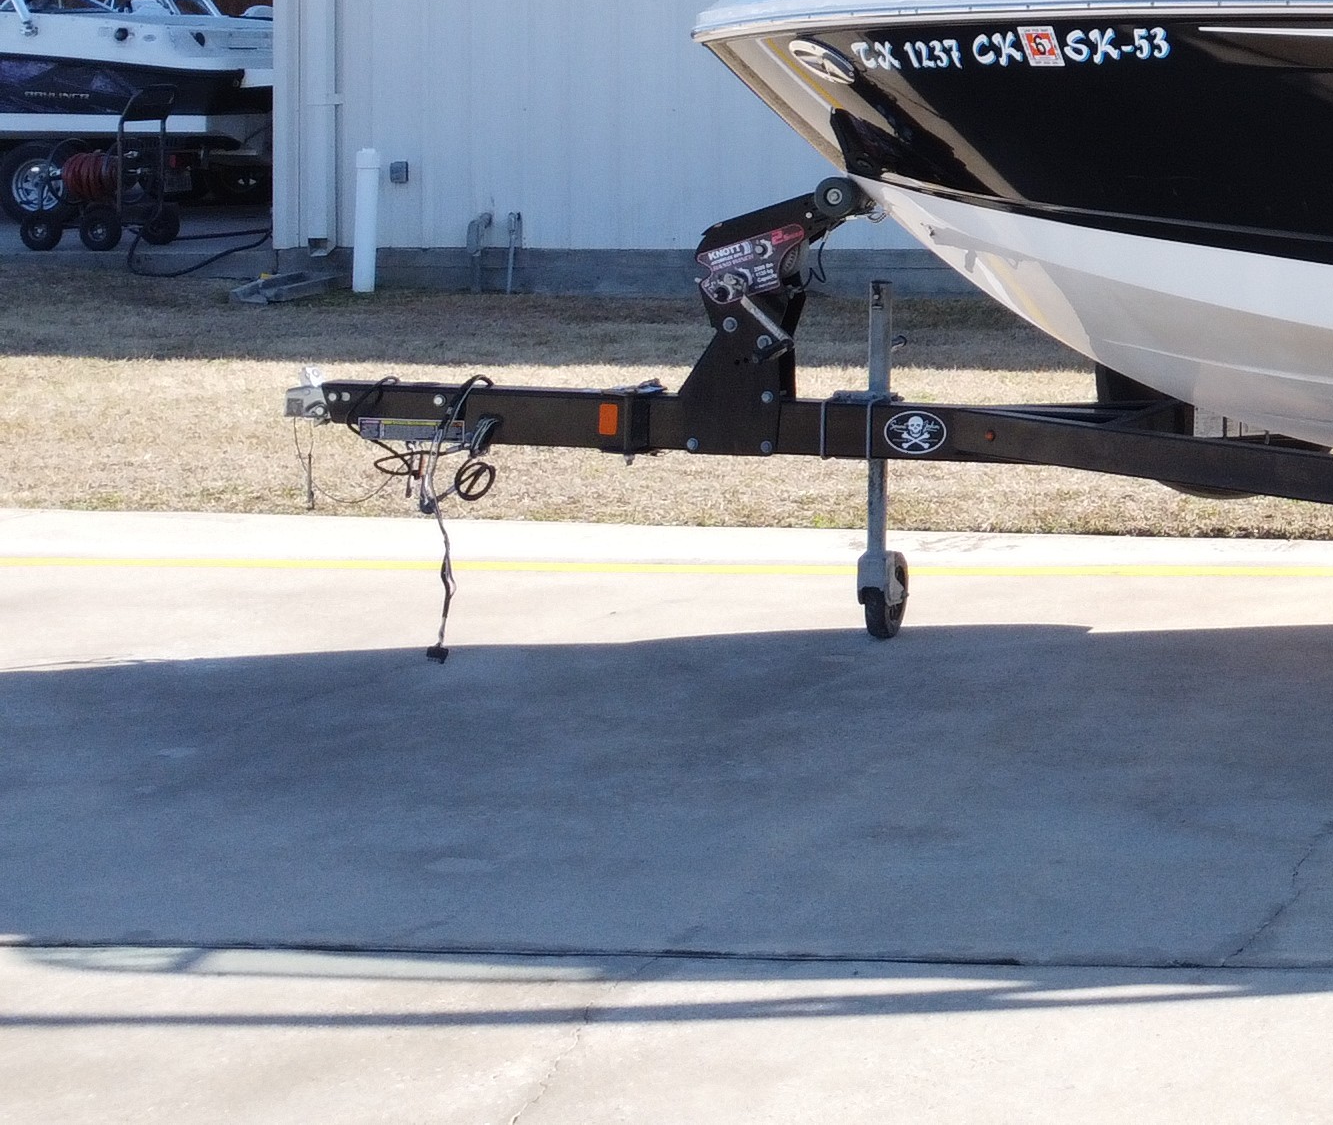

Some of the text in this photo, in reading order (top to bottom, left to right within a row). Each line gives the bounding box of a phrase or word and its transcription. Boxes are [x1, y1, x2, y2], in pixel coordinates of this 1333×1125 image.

[851, 40, 901, 70] TX
[904, 38, 963, 70] 1237
[707, 243, 740, 261] KNOTT
